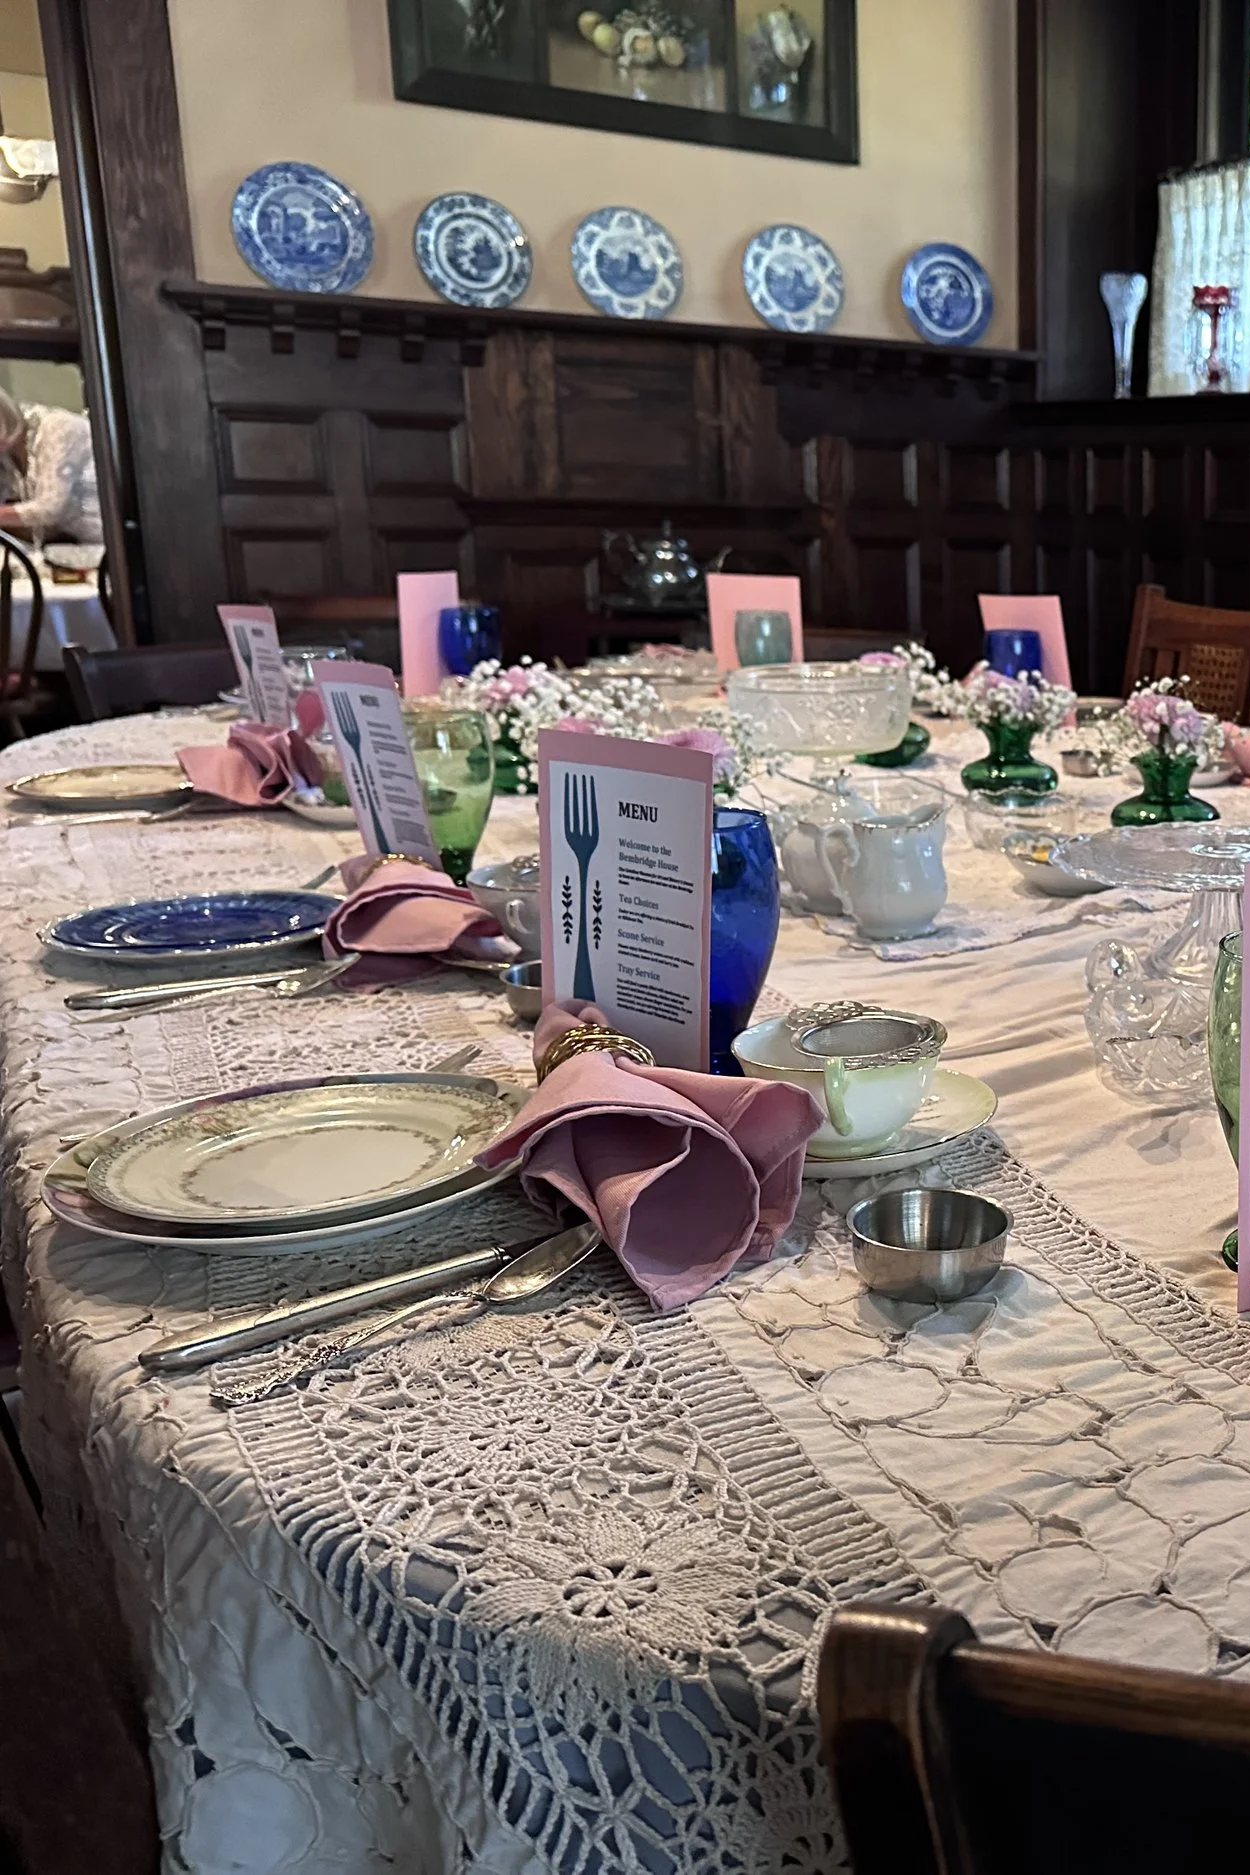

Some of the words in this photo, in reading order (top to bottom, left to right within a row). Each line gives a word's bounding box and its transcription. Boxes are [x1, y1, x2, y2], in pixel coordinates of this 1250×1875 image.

[619, 801, 658, 823] MENU
[619, 838, 651, 854] Welcome
[652, 845, 660, 854] to
[660, 846, 672, 857] the
[619, 852, 657, 869] Bembridge
[658, 859, 679, 872] House
[619, 894, 632, 905] Tea
[634, 896, 659, 910] Choices
[618, 929, 640, 942] Scone
[641, 933, 664, 947] Service
[618, 964, 635, 976] Tray
[636, 967, 660, 981] Service
